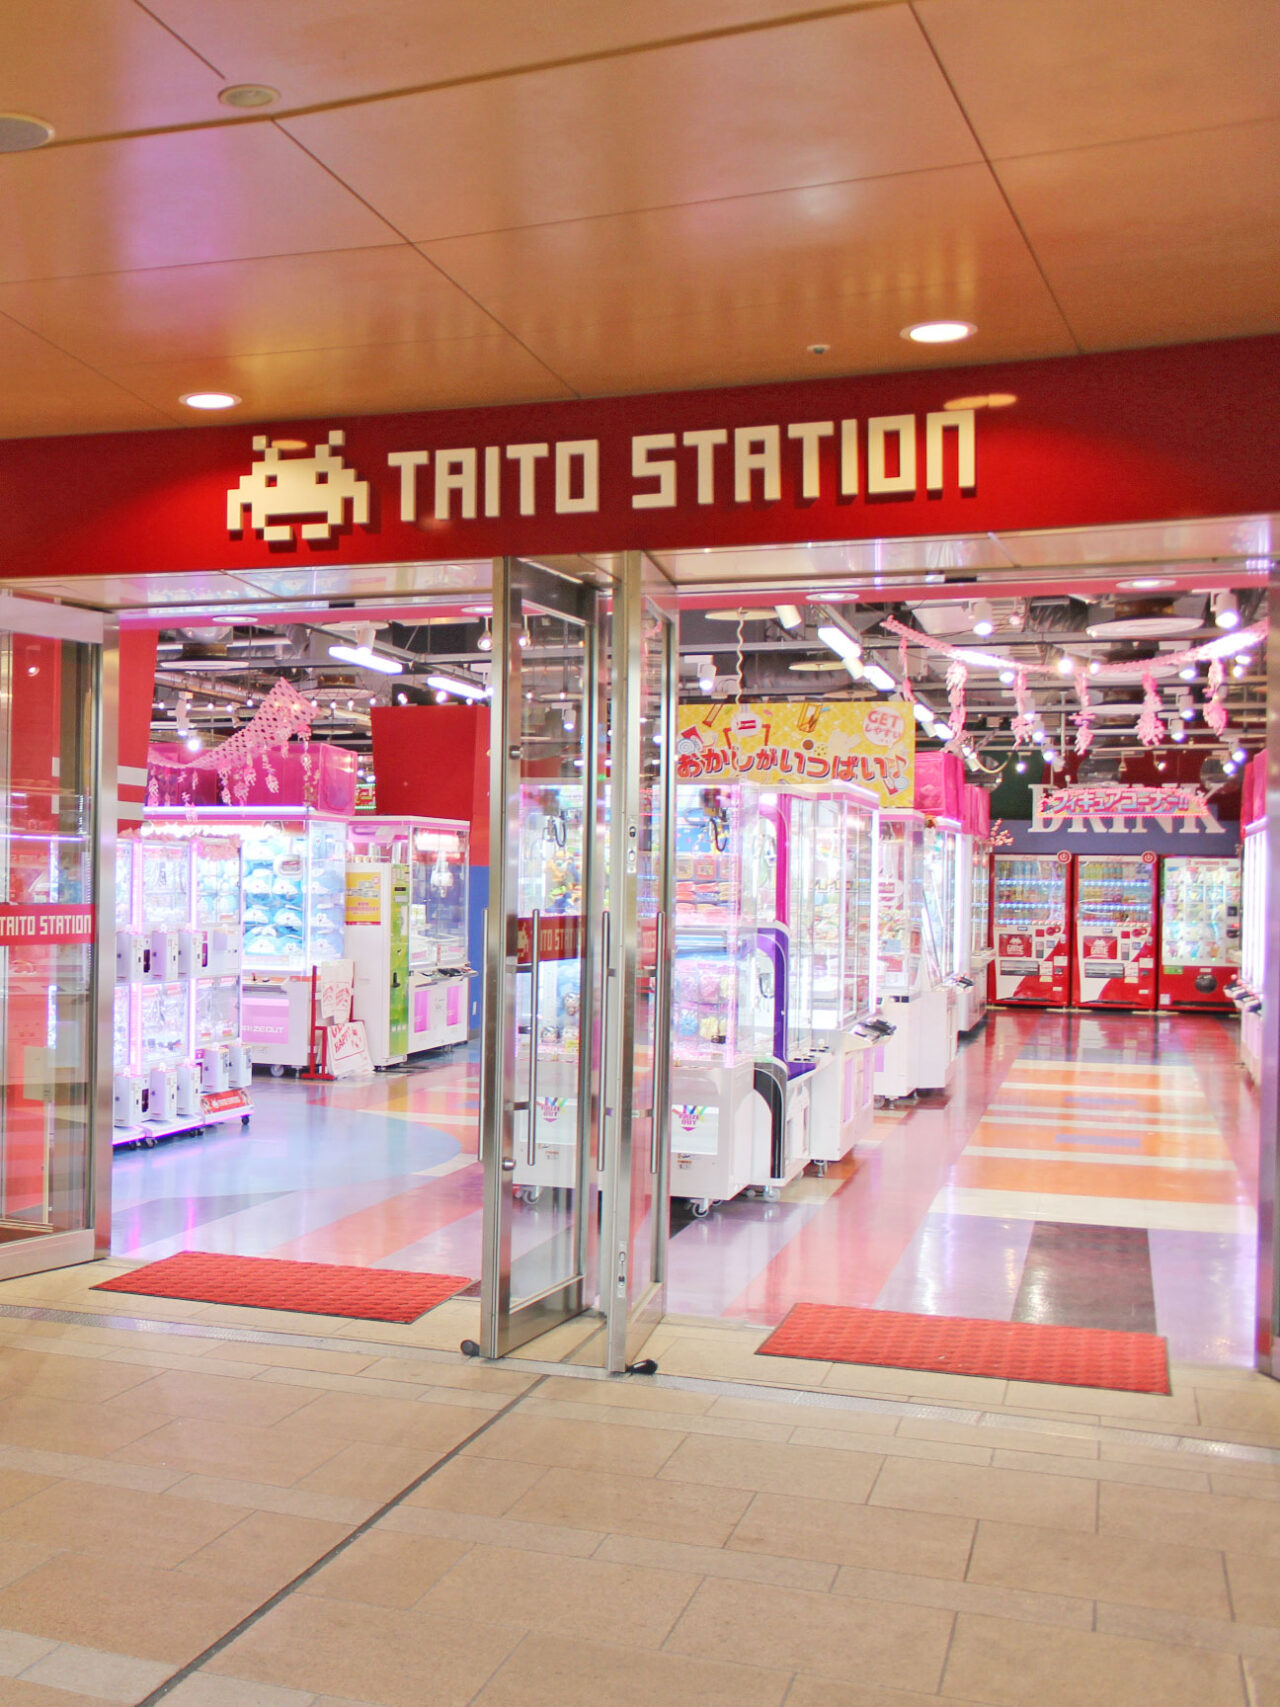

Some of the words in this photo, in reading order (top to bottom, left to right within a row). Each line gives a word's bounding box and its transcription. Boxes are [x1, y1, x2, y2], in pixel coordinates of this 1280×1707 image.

[387, 439, 599, 521] TAITO
[631, 409, 976, 510] STATION
[867, 710, 900, 728] GET
[39, 914, 92, 935] STATION
